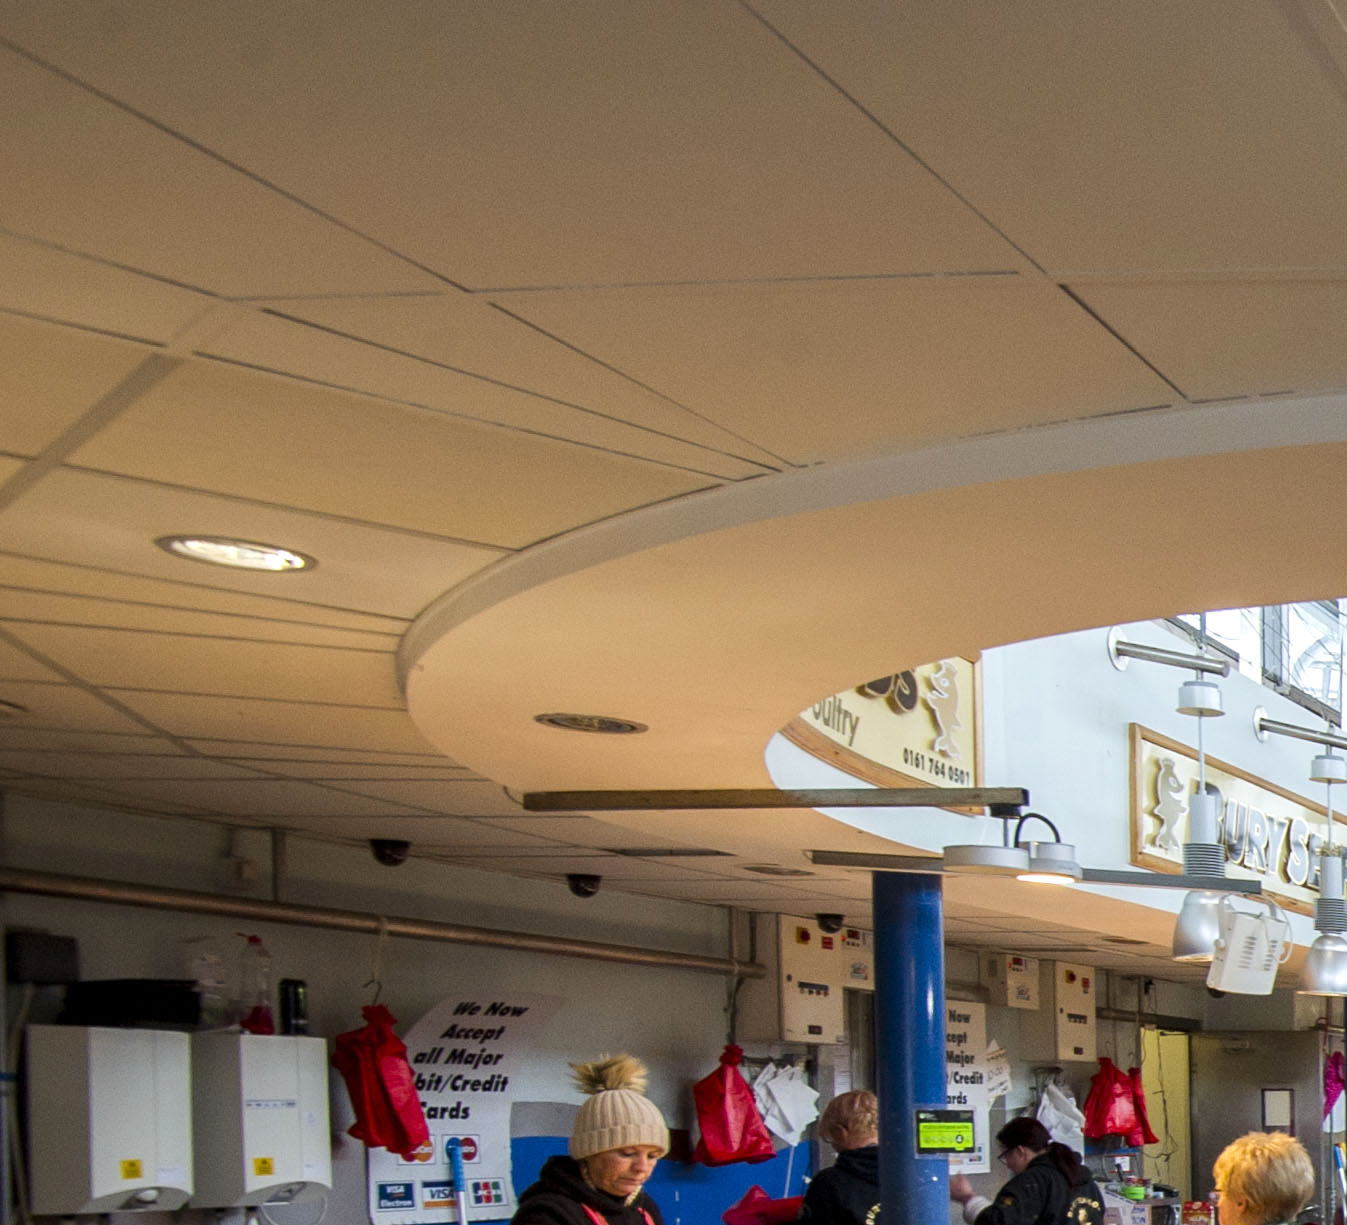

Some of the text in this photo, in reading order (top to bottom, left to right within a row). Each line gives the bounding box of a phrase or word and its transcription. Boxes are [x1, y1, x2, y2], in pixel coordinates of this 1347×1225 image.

[812, 696, 860, 746] oultry
[903, 748, 925, 770] 0161
[928, 757, 946, 778] 764
[453, 1002, 528, 1017] We Now
[948, 1010, 972, 1024] Now
[440, 1024, 506, 1044] Accept
[946, 1032, 968, 1047] cept
[413, 1047, 504, 1069] all Major
[414, 1073, 510, 1093] bit/Credit
[946, 1091, 968, 1104] ards
[429, 1188, 455, 1200] VISA
